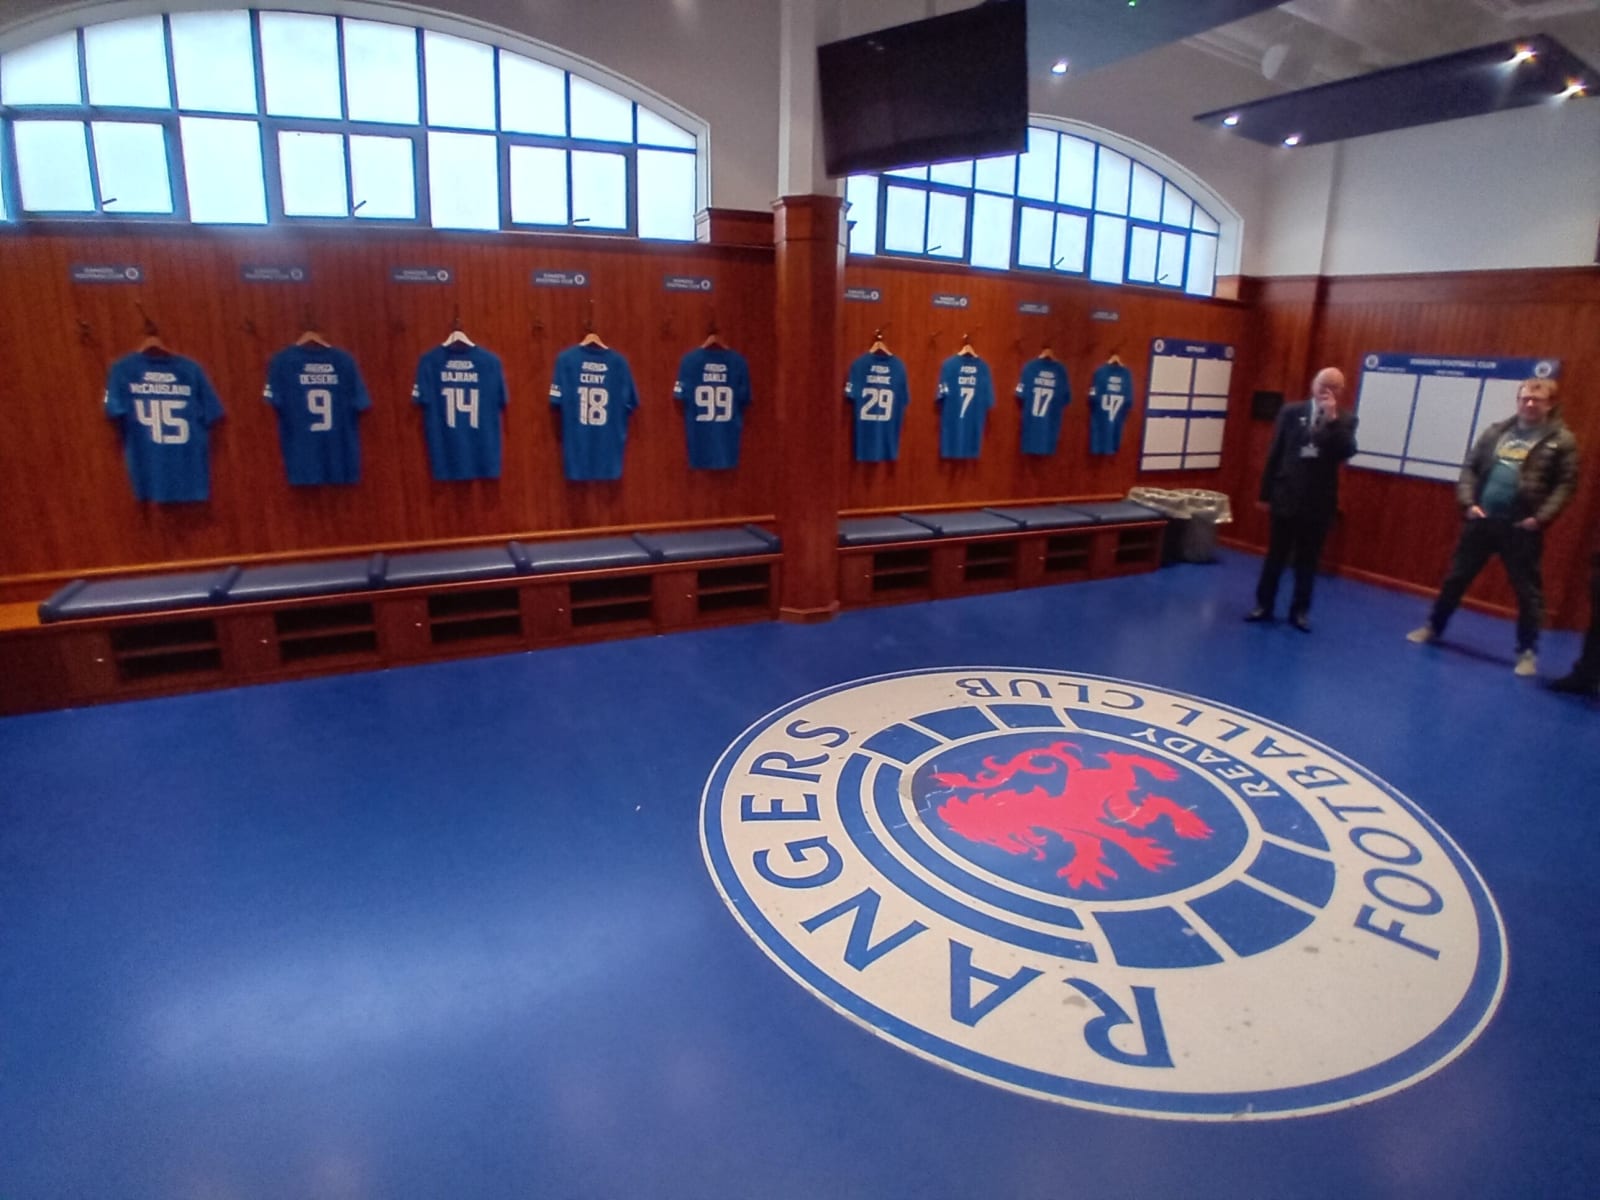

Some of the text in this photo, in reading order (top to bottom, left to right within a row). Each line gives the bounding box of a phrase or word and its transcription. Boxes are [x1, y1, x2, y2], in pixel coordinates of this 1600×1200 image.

[134, 399, 190, 444] 45
[307, 388, 332, 432] 9
[441, 387, 480, 429] 14
[577, 386, 608, 426] 18
[695, 385, 734, 422] 99
[860, 387, 894, 422] 29
[959, 387, 975, 419] 7
[1031, 387, 1054, 417] 17
[1101, 394, 1125, 422] 47
[1131, 727, 1281, 801] READY
[957, 676, 1446, 961] FOOTBALL CLUB
[740, 717, 1177, 1069] RANGERS
